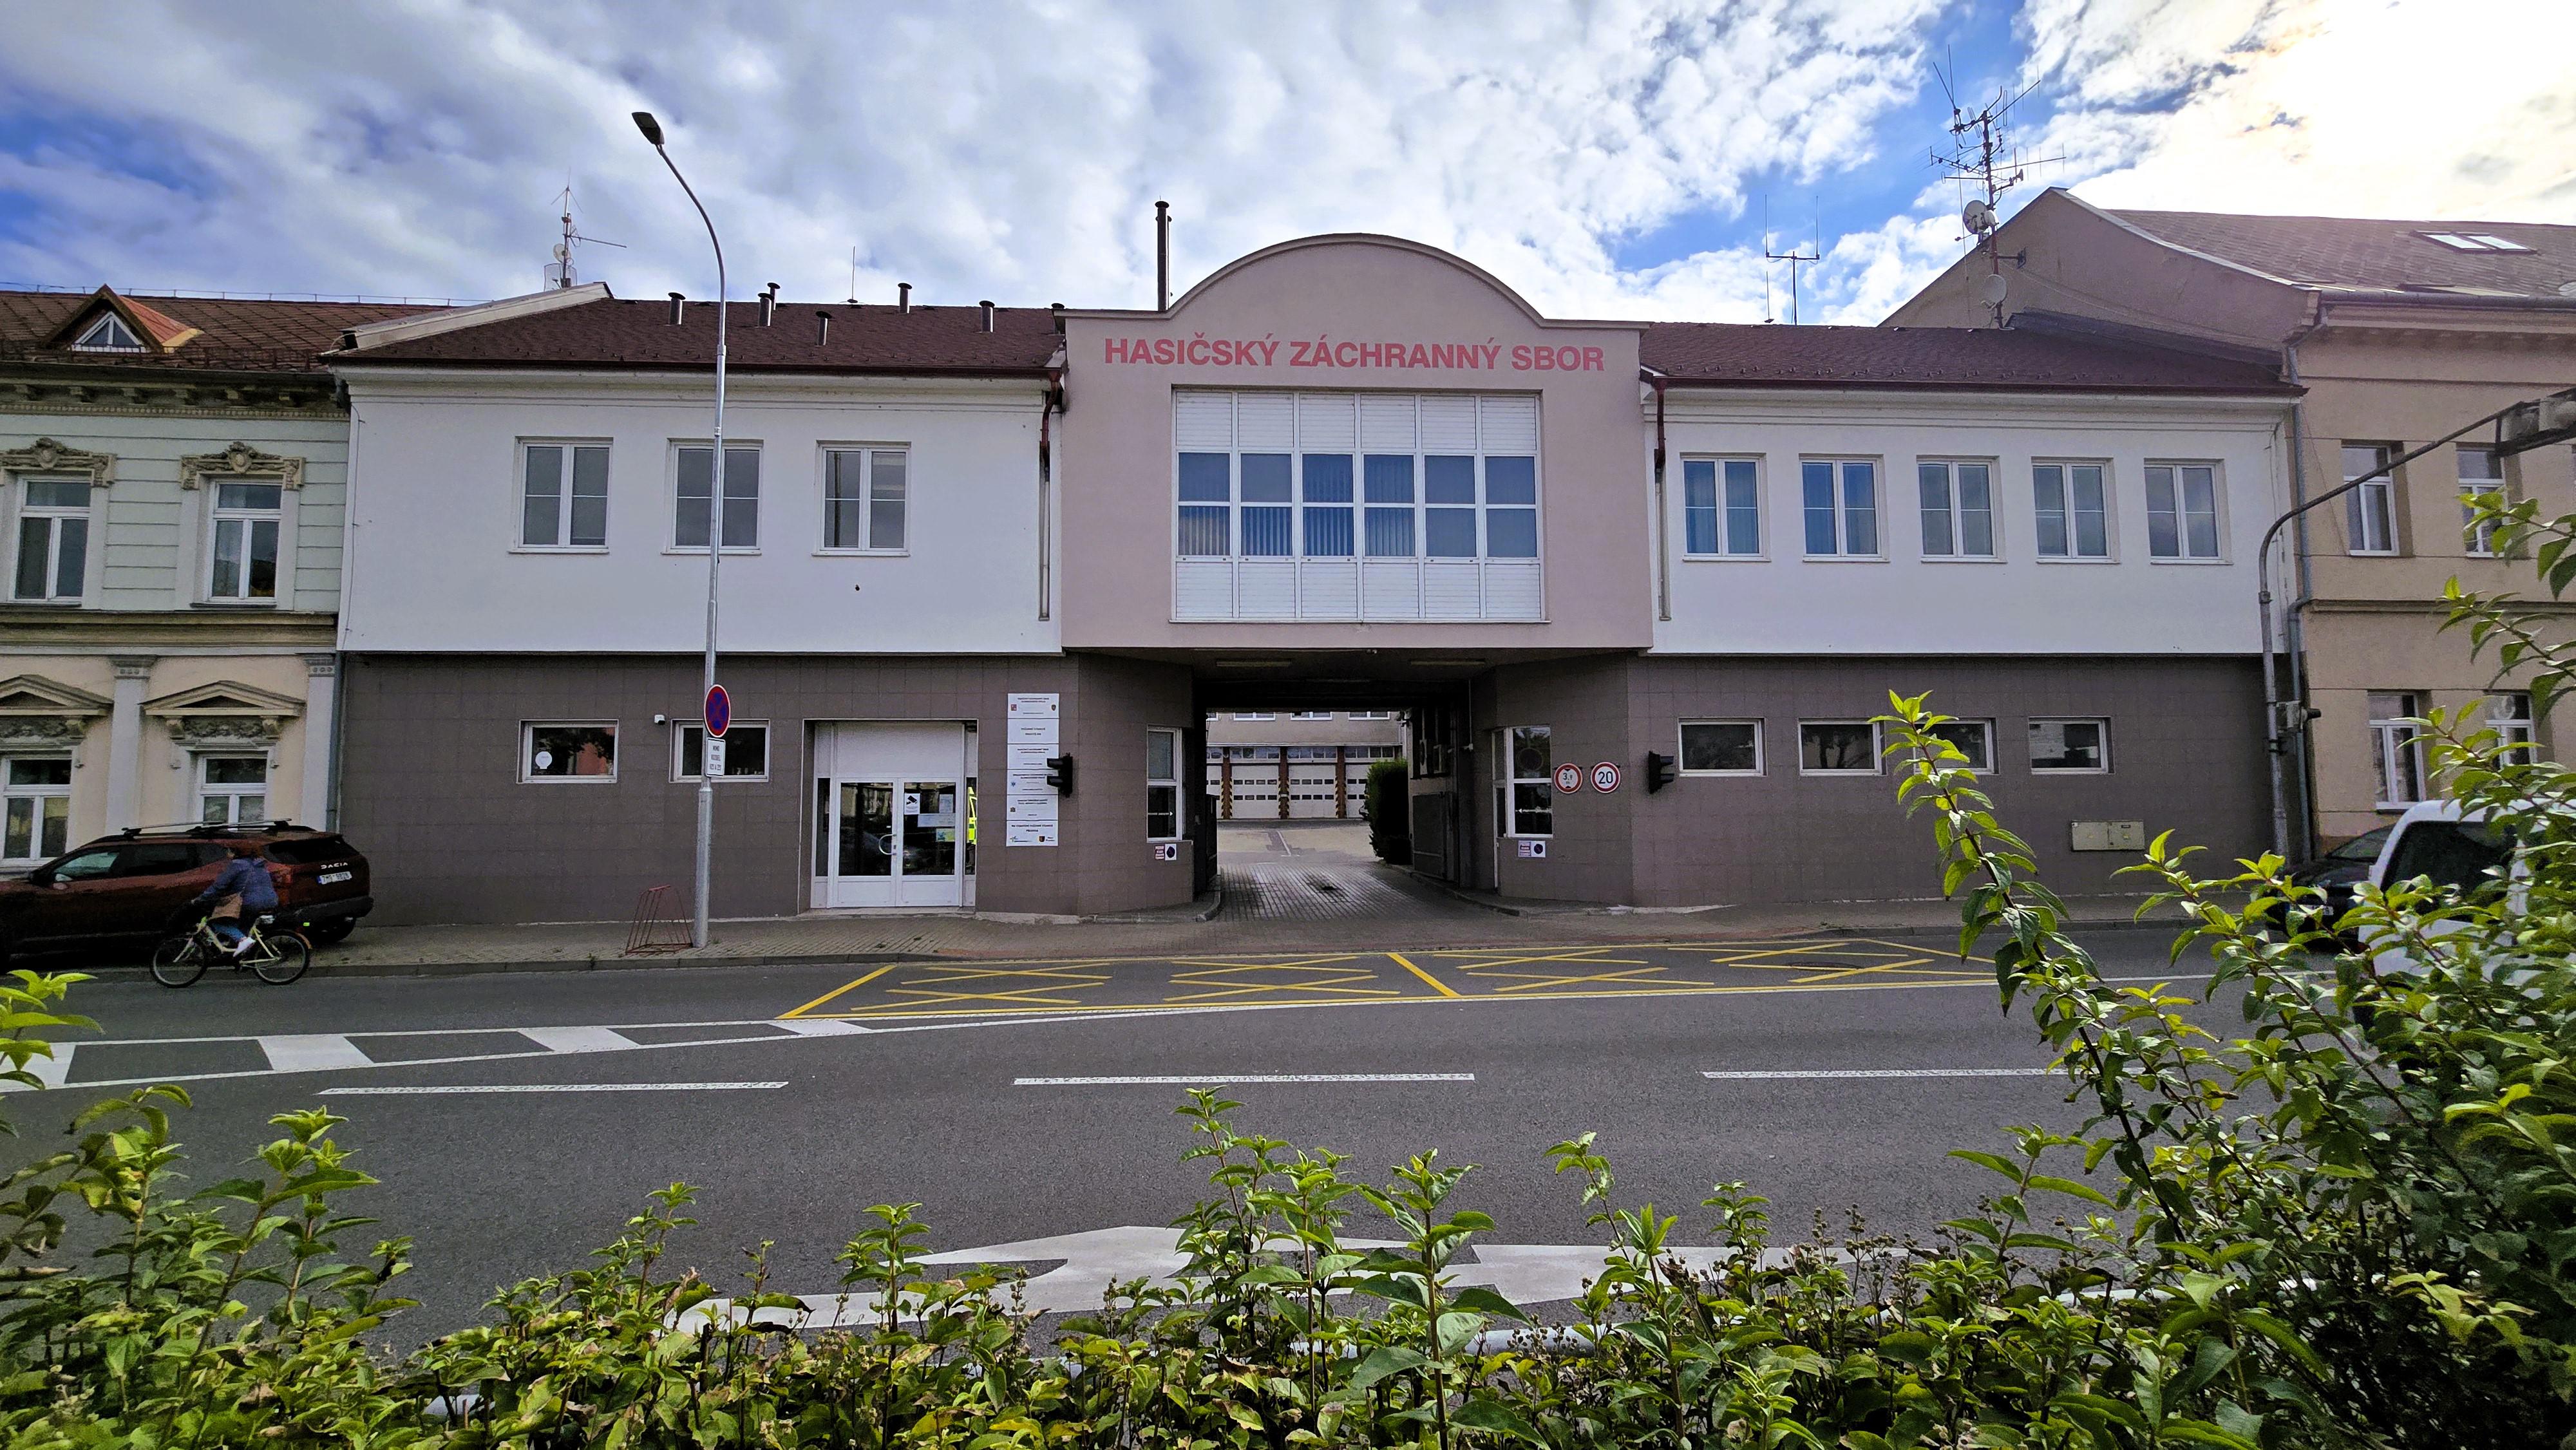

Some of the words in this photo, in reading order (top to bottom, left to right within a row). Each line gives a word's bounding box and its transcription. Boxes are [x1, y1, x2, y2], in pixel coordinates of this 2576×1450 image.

[1104, 332, 1280, 367] HASIČSKÝ
[1289, 337, 1501, 370] ZÁCHRANNÝ
[1511, 345, 1605, 372] SBOR
[1598, 771, 1613, 784] 20
